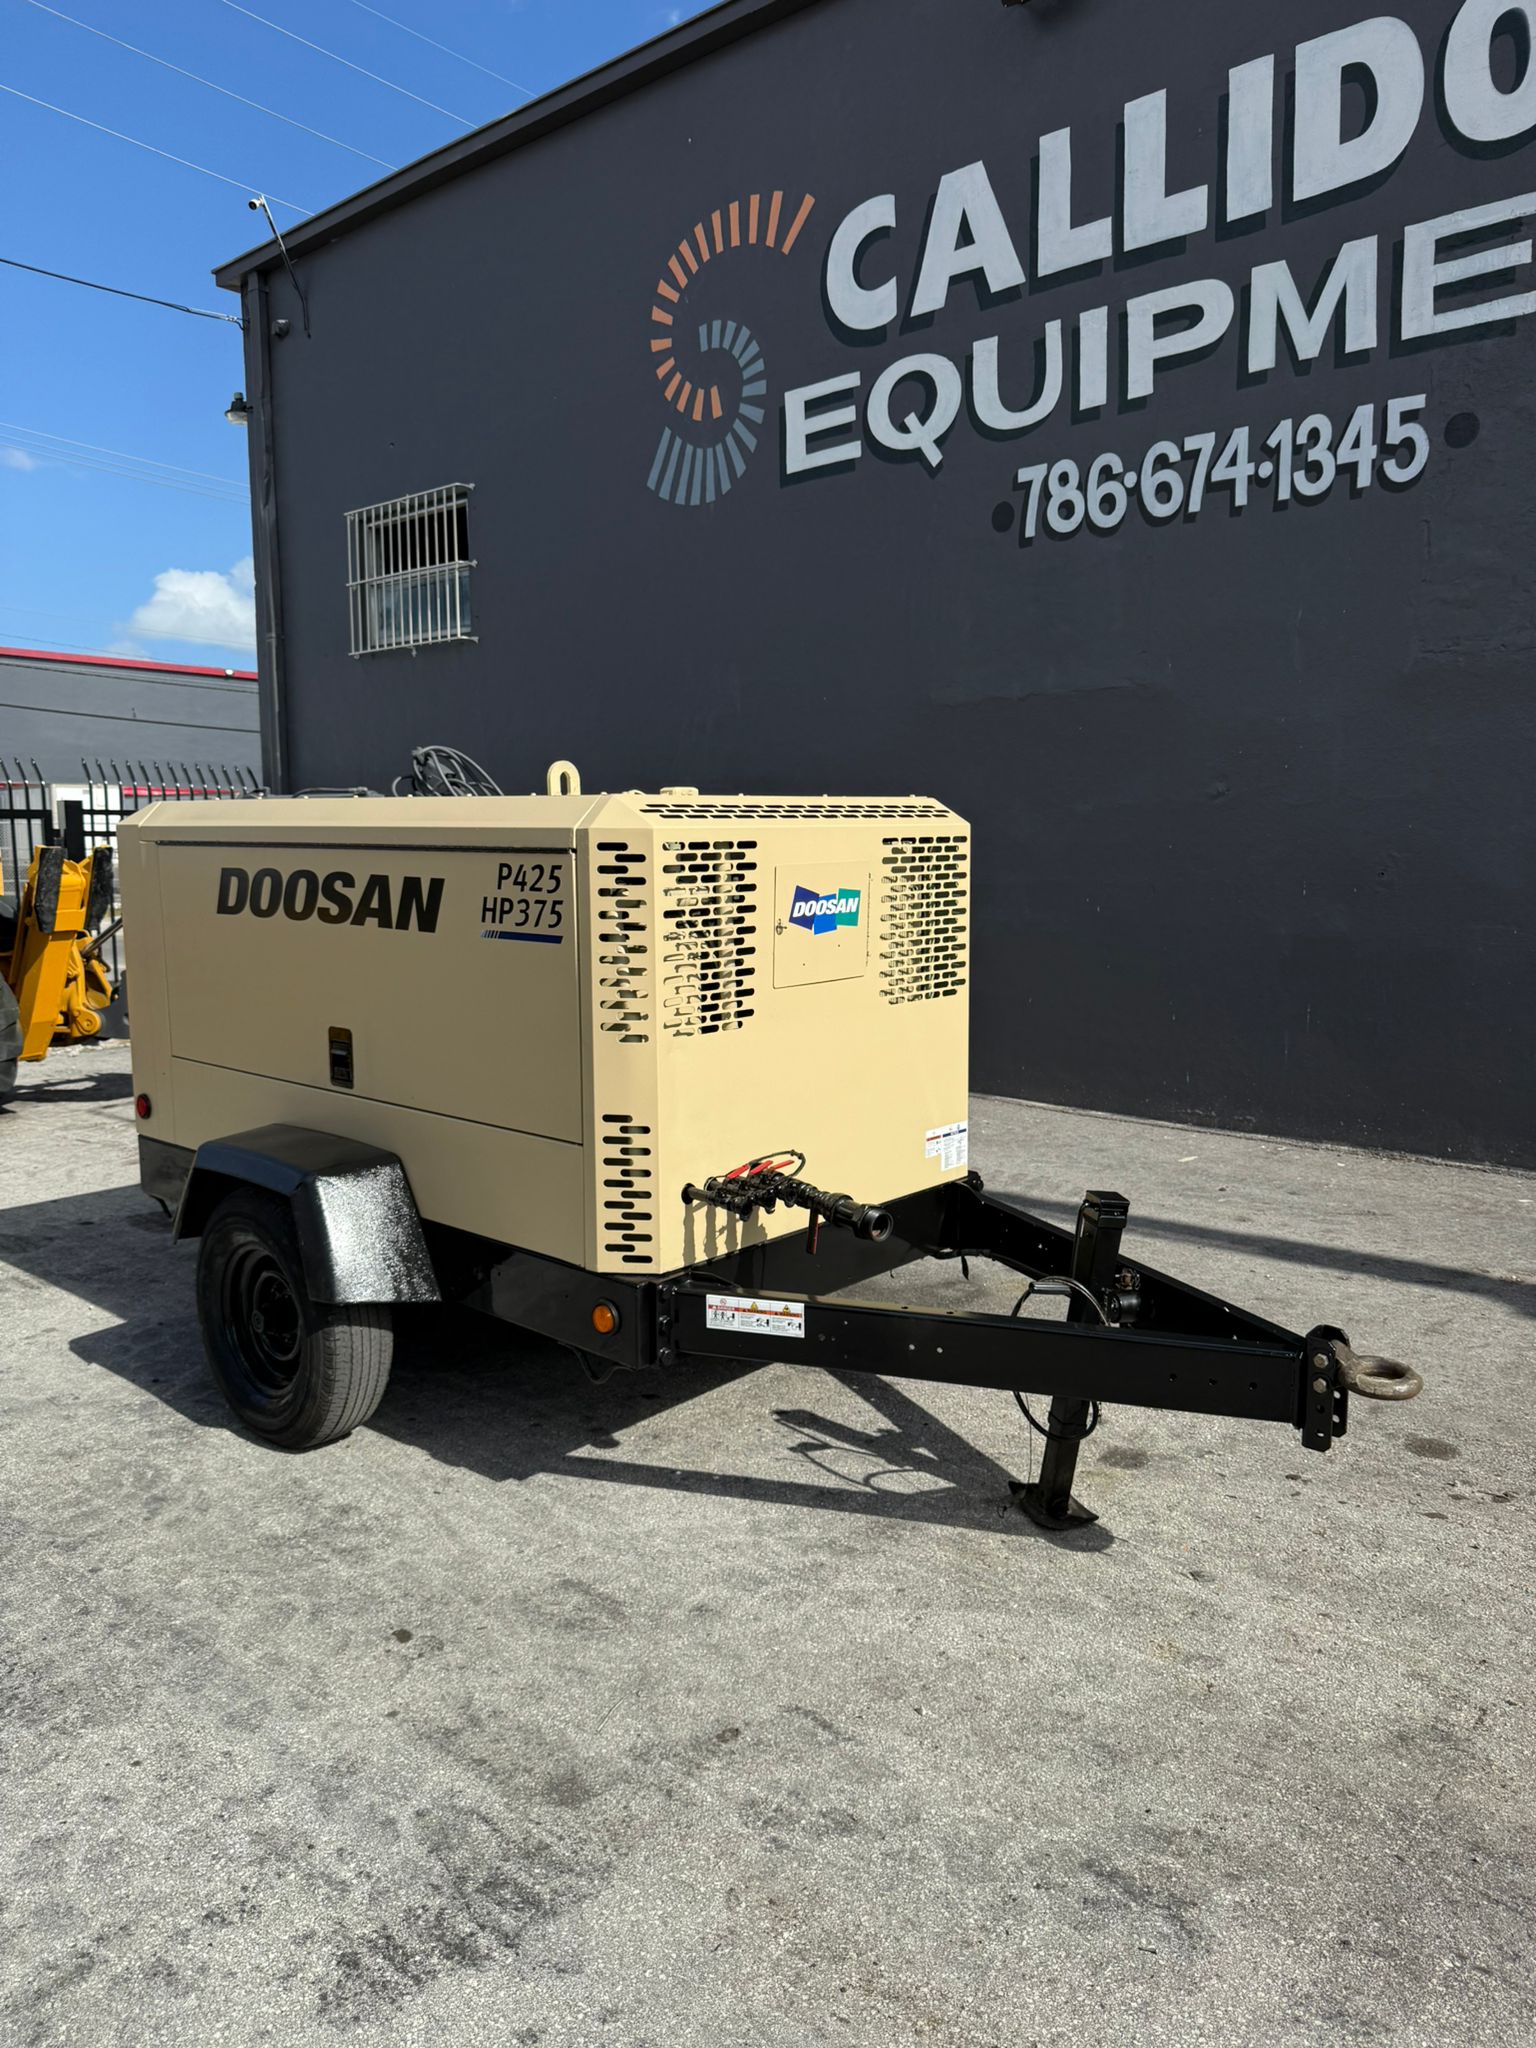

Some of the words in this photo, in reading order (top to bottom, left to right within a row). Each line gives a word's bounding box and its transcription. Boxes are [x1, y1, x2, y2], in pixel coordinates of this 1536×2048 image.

[826, 0, 1536, 331] CALLIDO
[783, 191, 1536, 476] EQUIPME
[216, 867, 445, 933] DOOSAN
[497, 863, 563, 894] P425
[481, 896, 563, 928] HP375
[792, 897, 859, 918] DOOSAN
